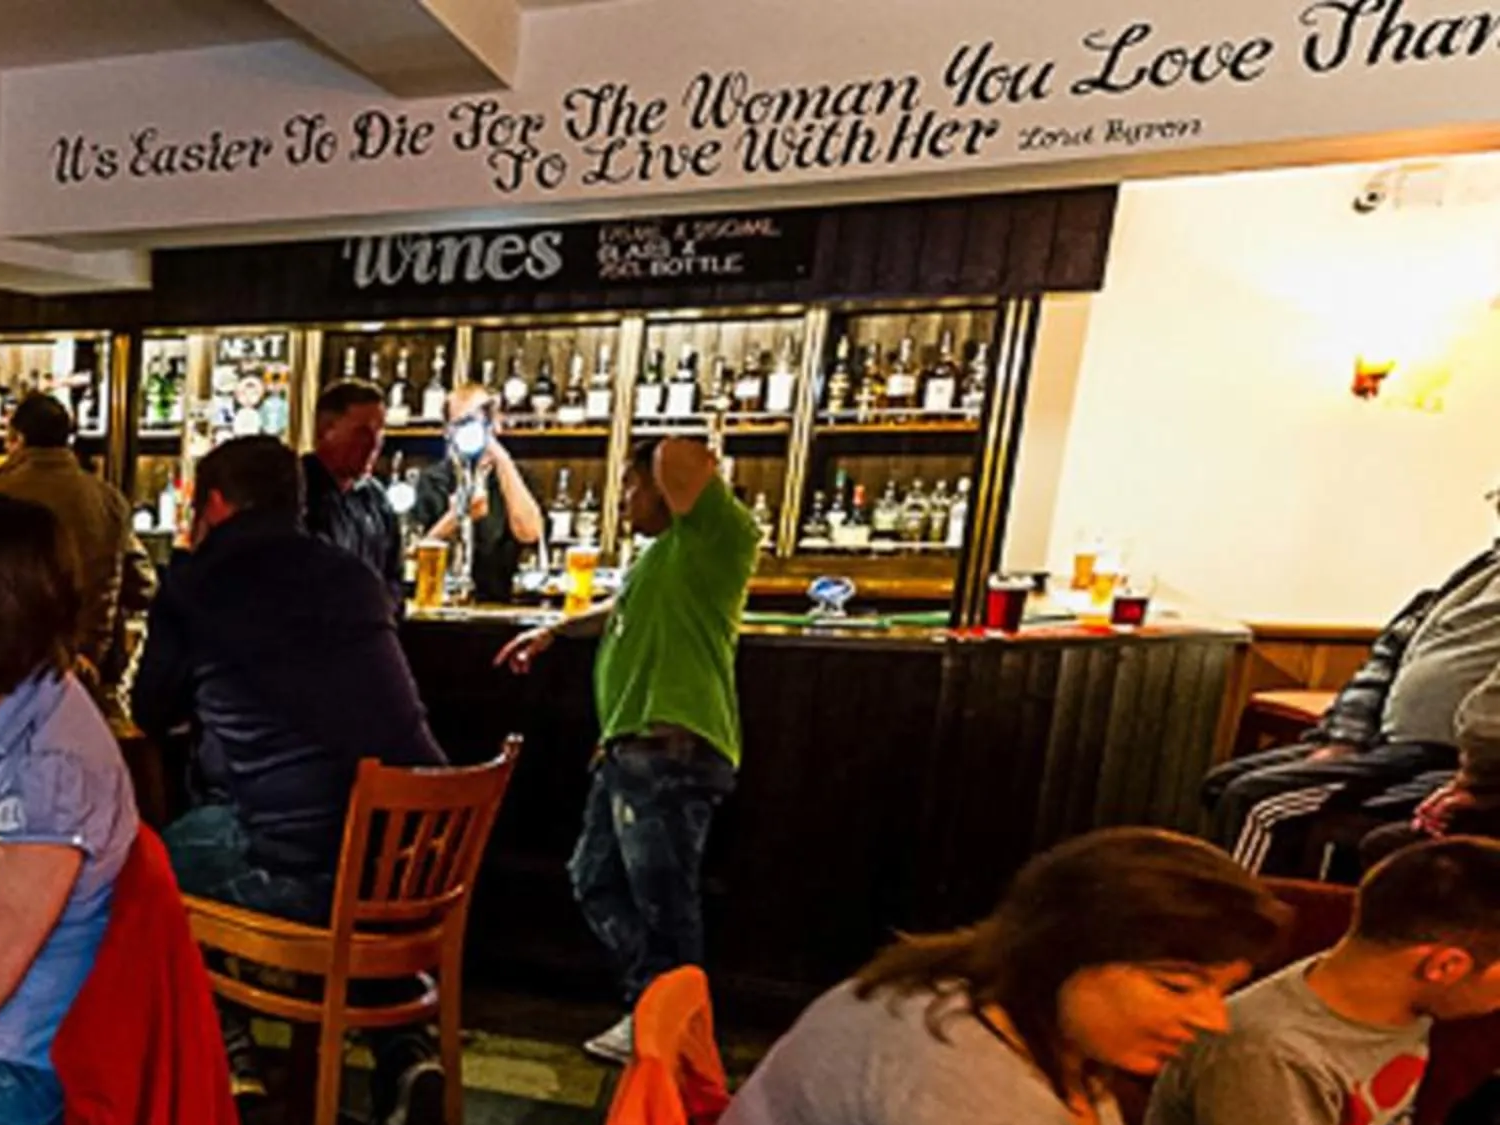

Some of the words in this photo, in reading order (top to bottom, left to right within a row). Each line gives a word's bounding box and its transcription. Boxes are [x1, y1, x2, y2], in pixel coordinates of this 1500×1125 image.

[55, 133, 118, 184] It's
[129, 126, 272, 177] Easier
[285, 114, 338, 166] To
[350, 109, 434, 161] Die
[448, 99, 546, 154] For
[563, 83, 667, 142] The
[681, 72, 921, 131] Woman
[944, 41, 1054, 108] You
[1070, 22, 1274, 95] Love
[1104, 117, 1202, 145] Byron
[488, 149, 567, 193] To
[582, 137, 721, 185] Live
[733, 118, 881, 173] With
[886, 110, 1000, 159] Her
[342, 229, 563, 288] Wines
[650, 253, 744, 277] BOTTLE
